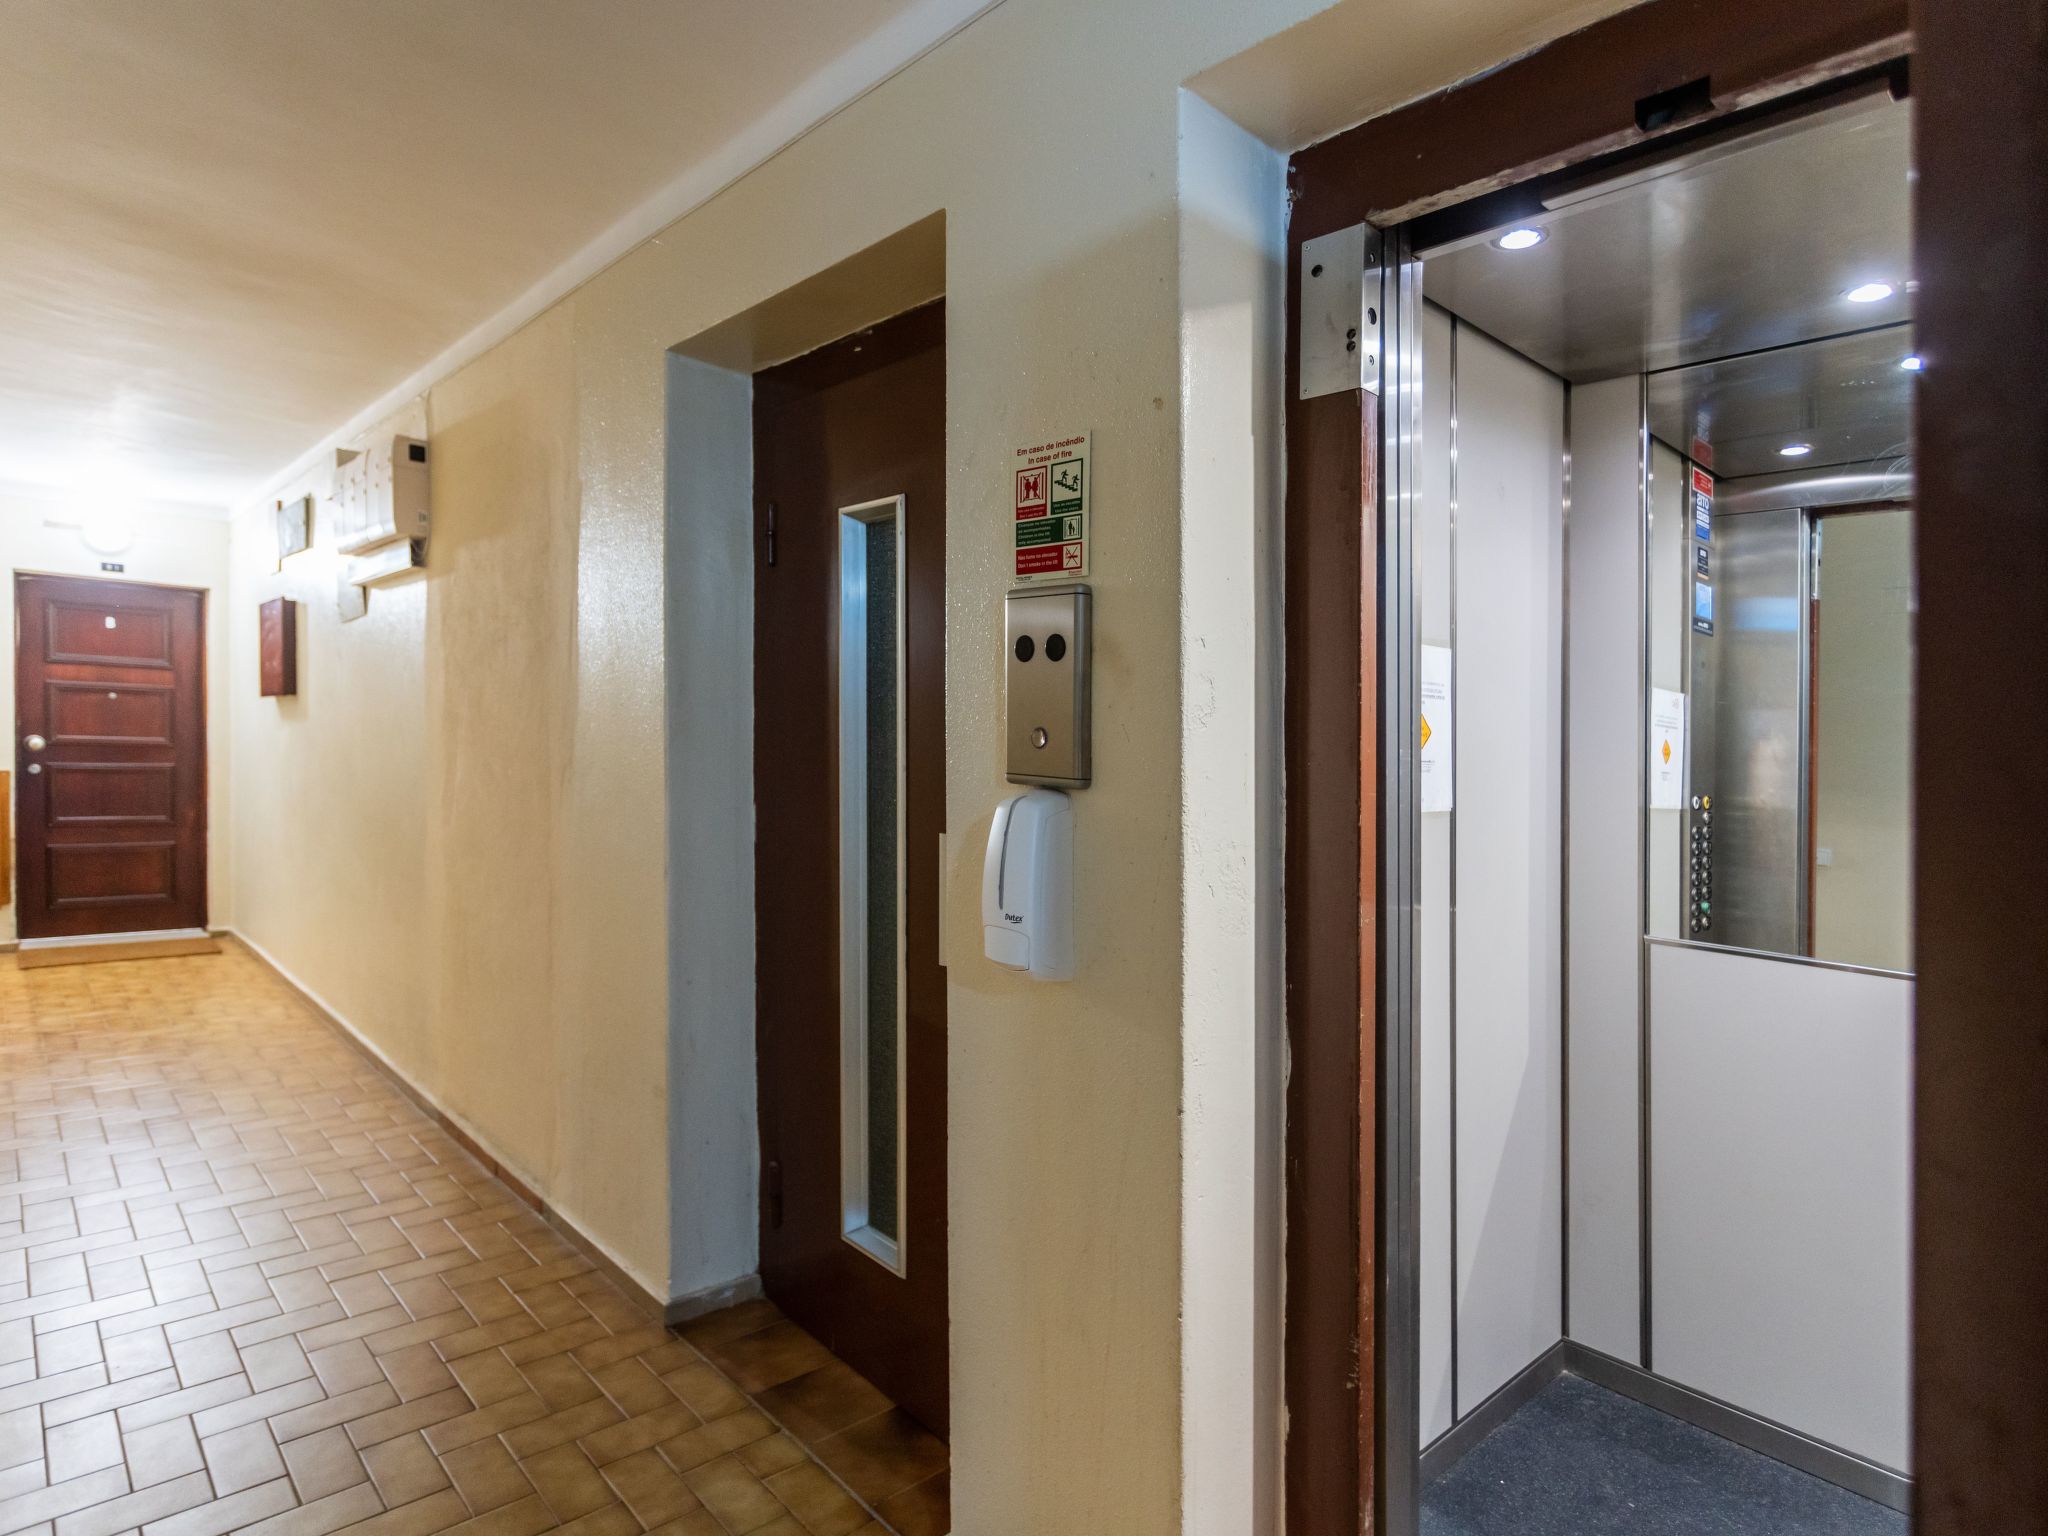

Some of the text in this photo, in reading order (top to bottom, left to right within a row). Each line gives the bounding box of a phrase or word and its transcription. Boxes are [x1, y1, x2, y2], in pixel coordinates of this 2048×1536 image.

[1016, 436, 1085, 457] Em caso de incêndio
[1036, 454, 1051, 463] case
[1052, 452, 1060, 460] of
[1061, 450, 1072, 459] fire
